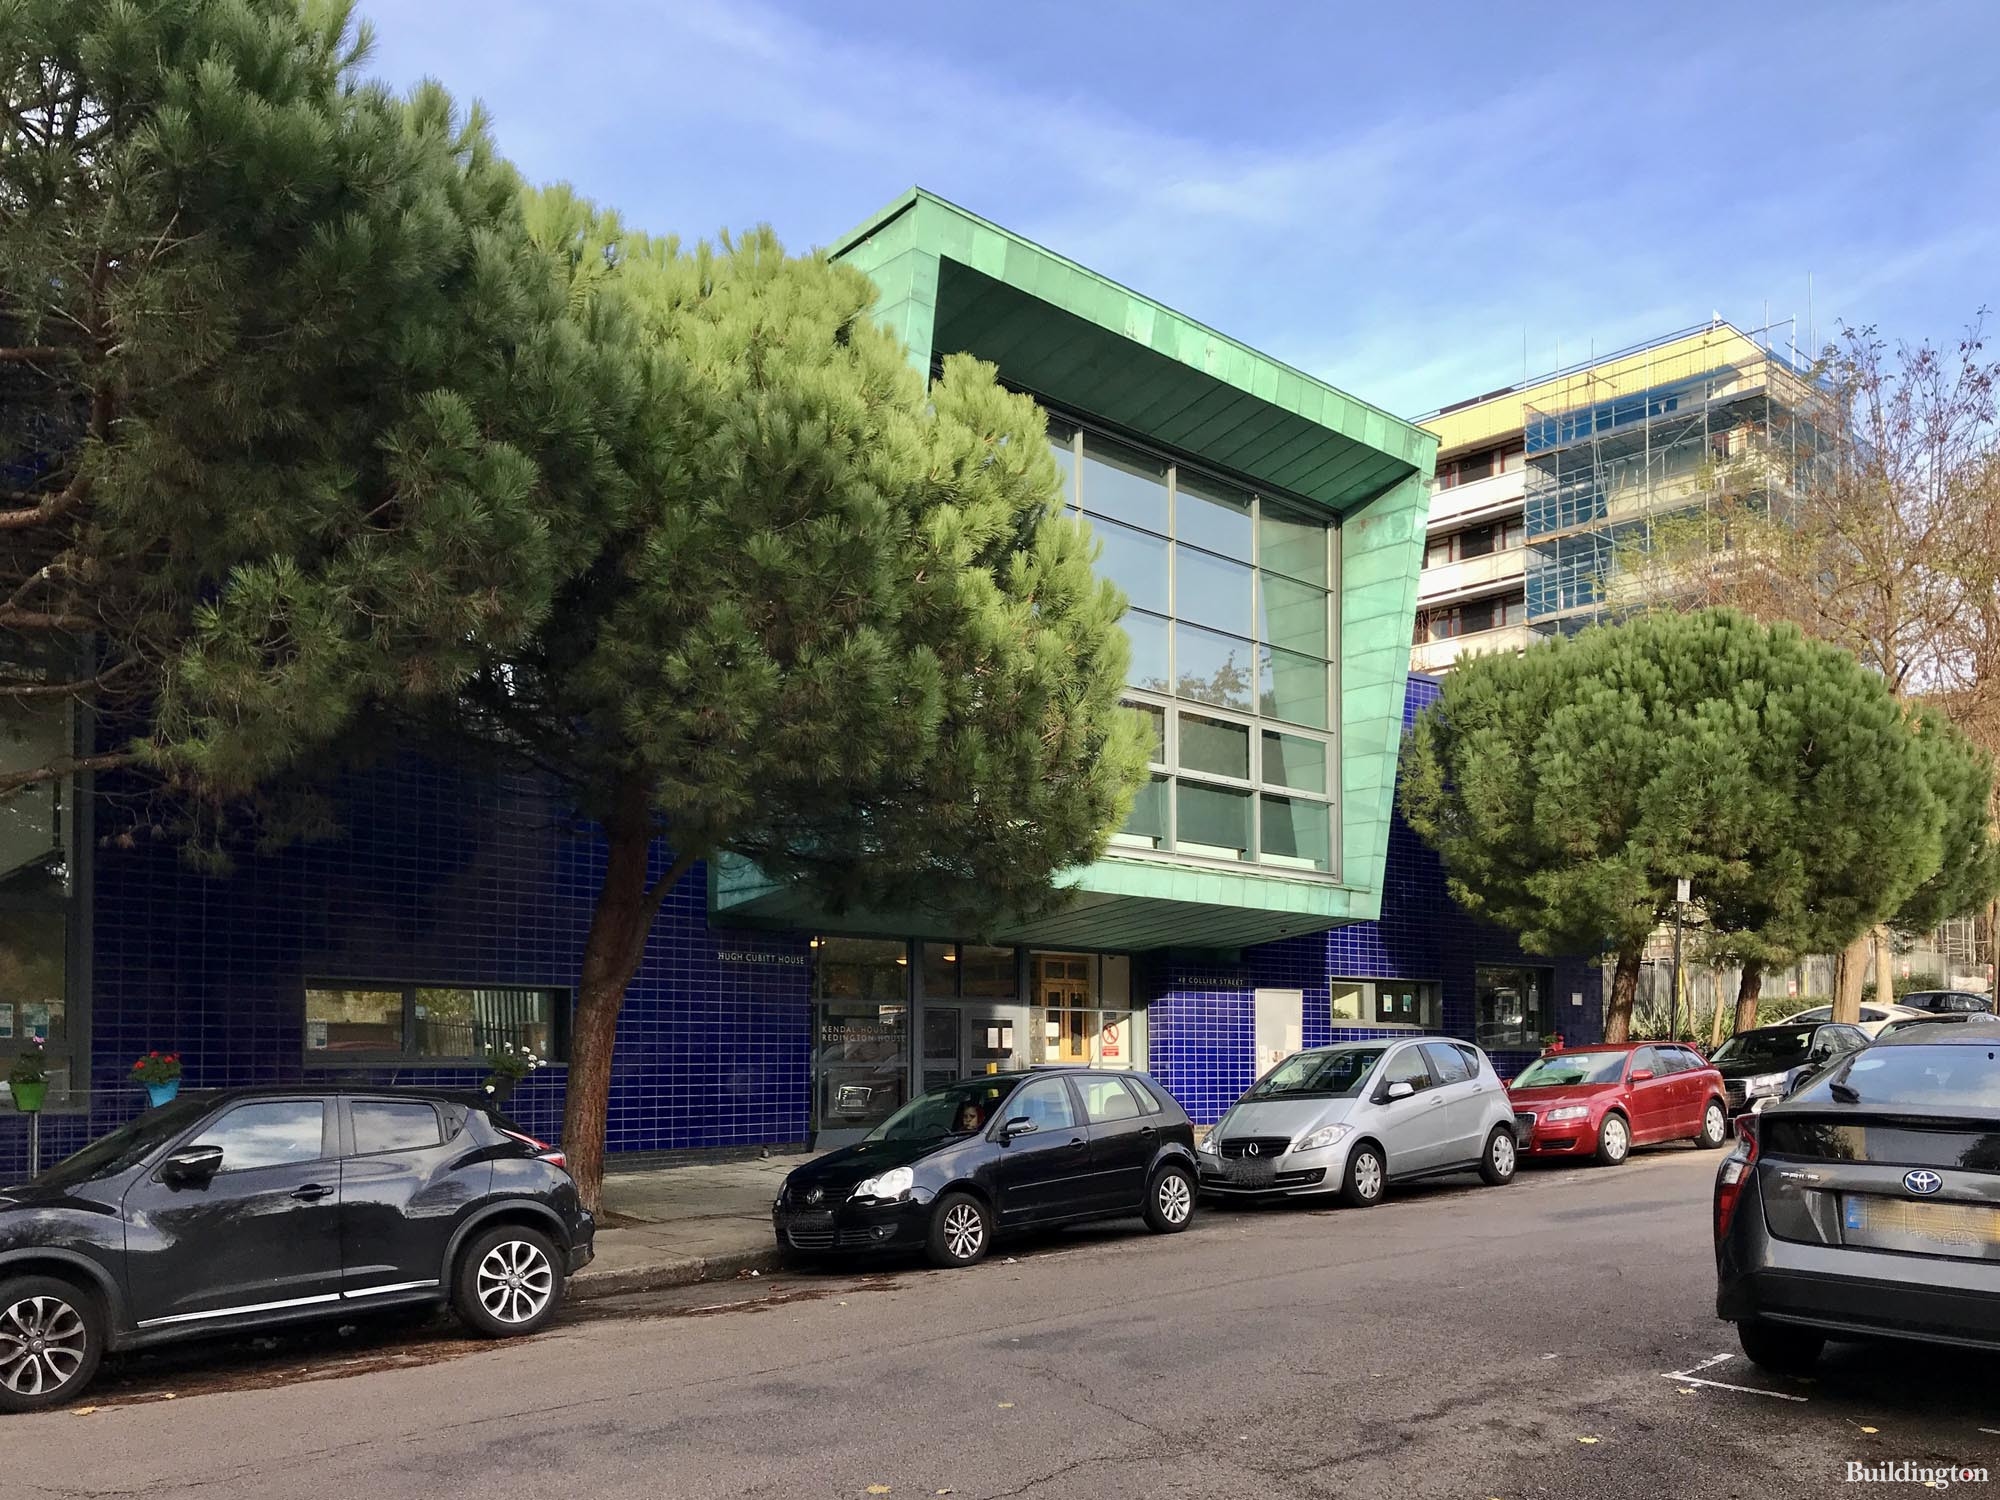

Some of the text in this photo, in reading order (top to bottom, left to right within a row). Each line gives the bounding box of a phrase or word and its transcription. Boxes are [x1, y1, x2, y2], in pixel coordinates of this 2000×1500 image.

[717, 952, 804, 965] HUGH CUBITT HOUSE
[1188, 977, 1217, 985] COLLIER
[1219, 978, 1244, 986] STREET
[822, 1025, 856, 1034] KENDAL
[861, 1025, 888, 1034] HOUSE
